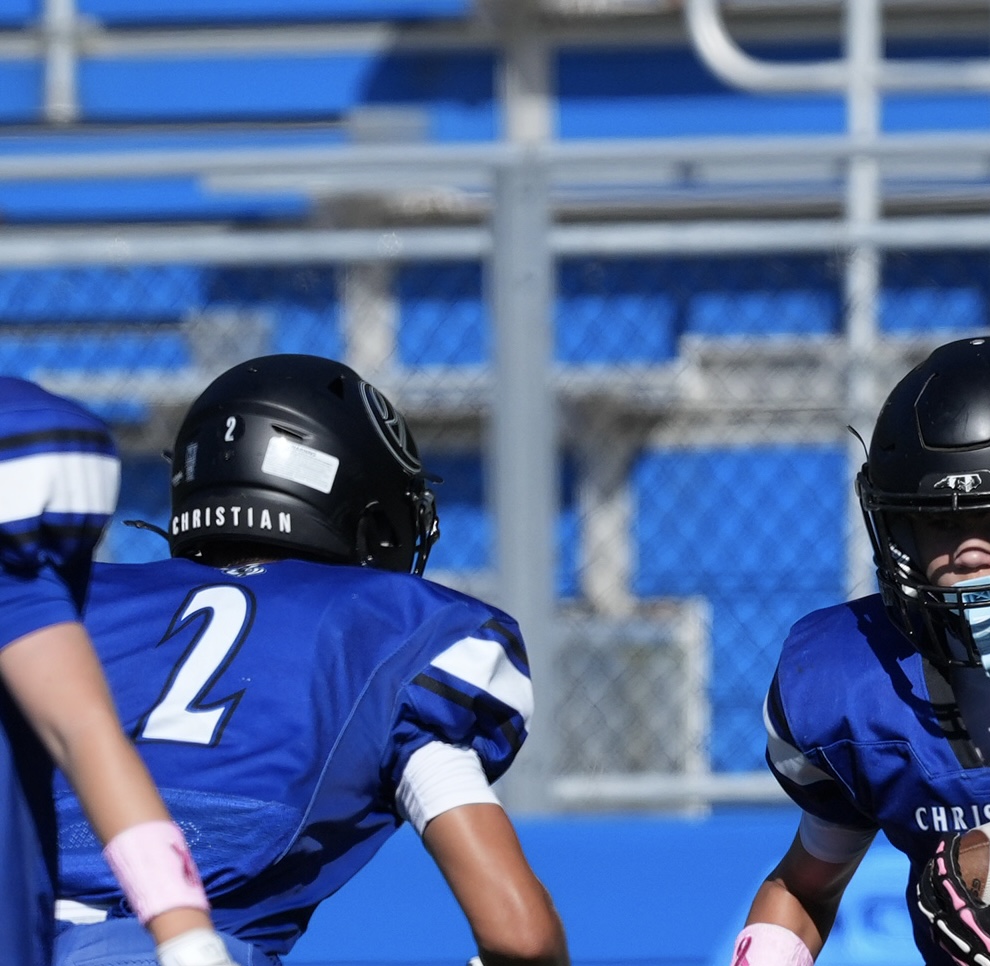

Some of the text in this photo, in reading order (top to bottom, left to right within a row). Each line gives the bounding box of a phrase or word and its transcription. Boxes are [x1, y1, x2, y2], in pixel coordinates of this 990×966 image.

[224, 416, 236, 441] 2
[172, 506, 291, 535] CHRISTIAN
[132, 582, 256, 748] 2
